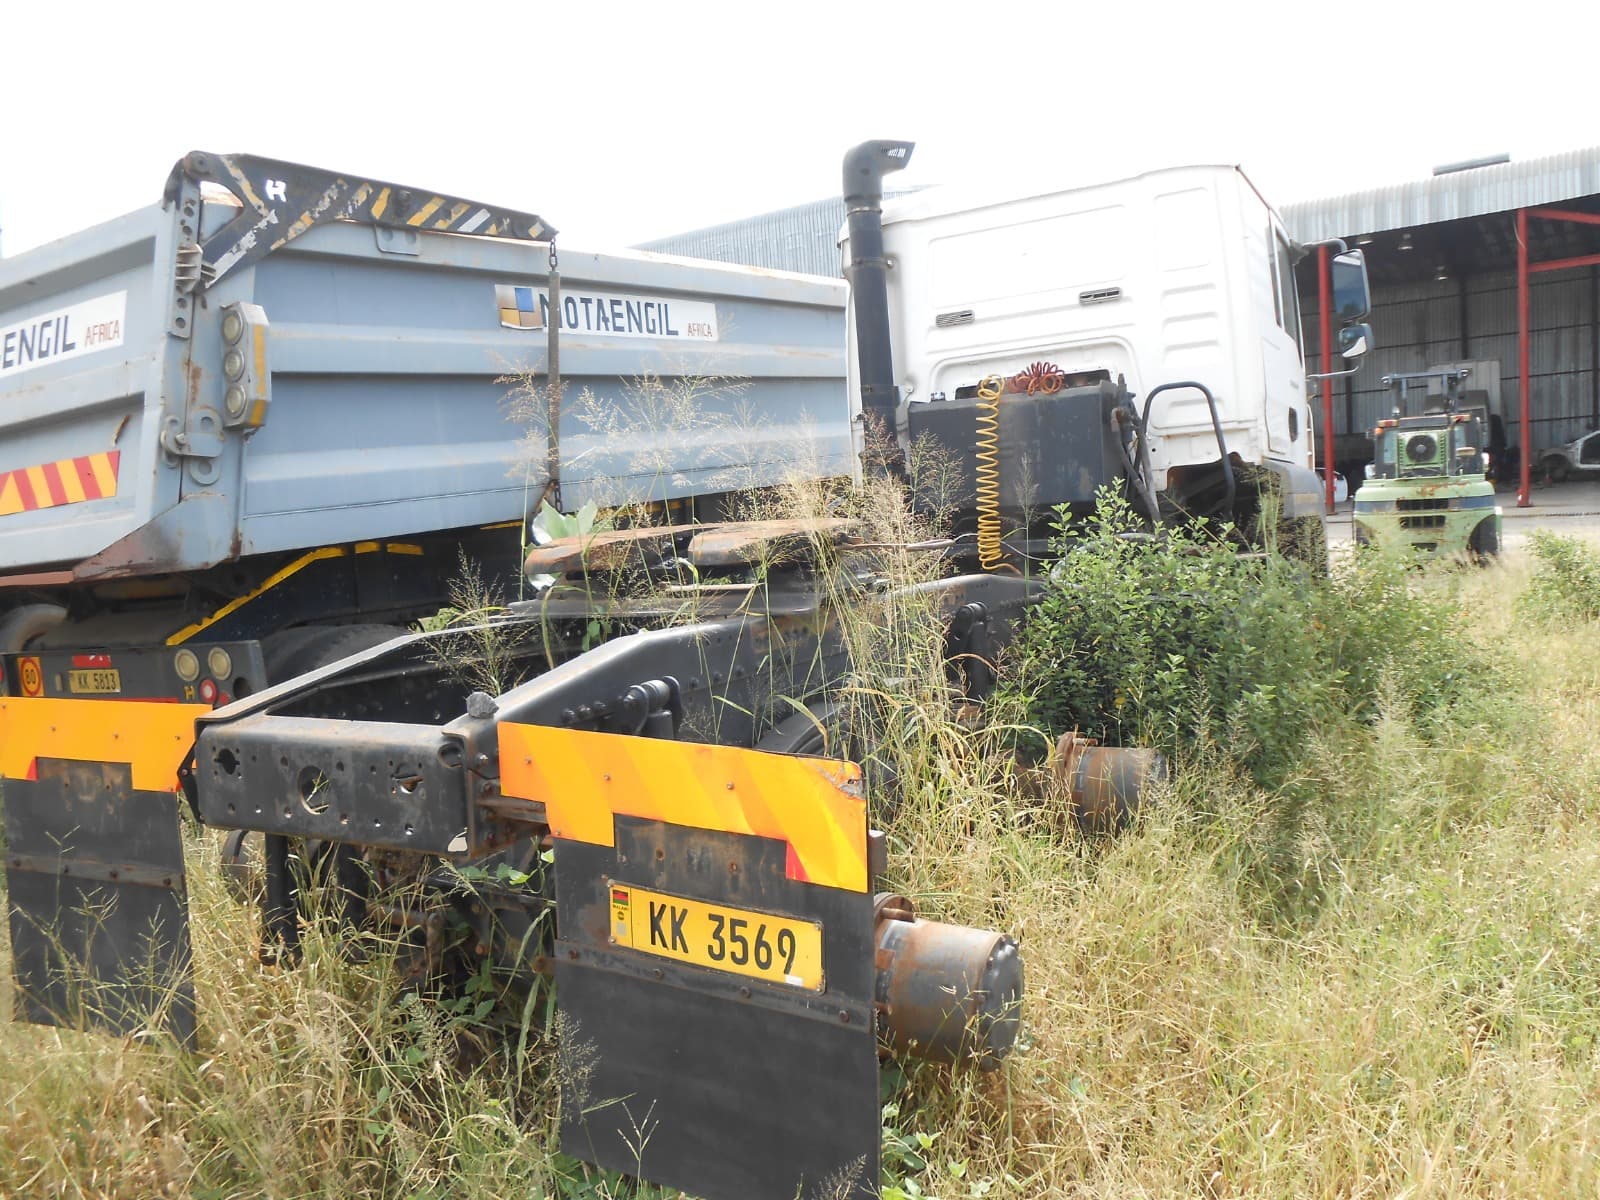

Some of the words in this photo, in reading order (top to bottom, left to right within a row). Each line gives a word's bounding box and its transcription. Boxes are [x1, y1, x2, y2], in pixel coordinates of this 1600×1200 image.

[2, 315, 76, 369] ENGIL
[85, 320, 120, 346] AFRICA
[687, 322, 712, 337] AFRICA
[78, 673, 90, 690] KK
[93, 672, 117, 690] 5813
[649, 901, 689, 954] KK
[707, 912, 797, 975] 3569
